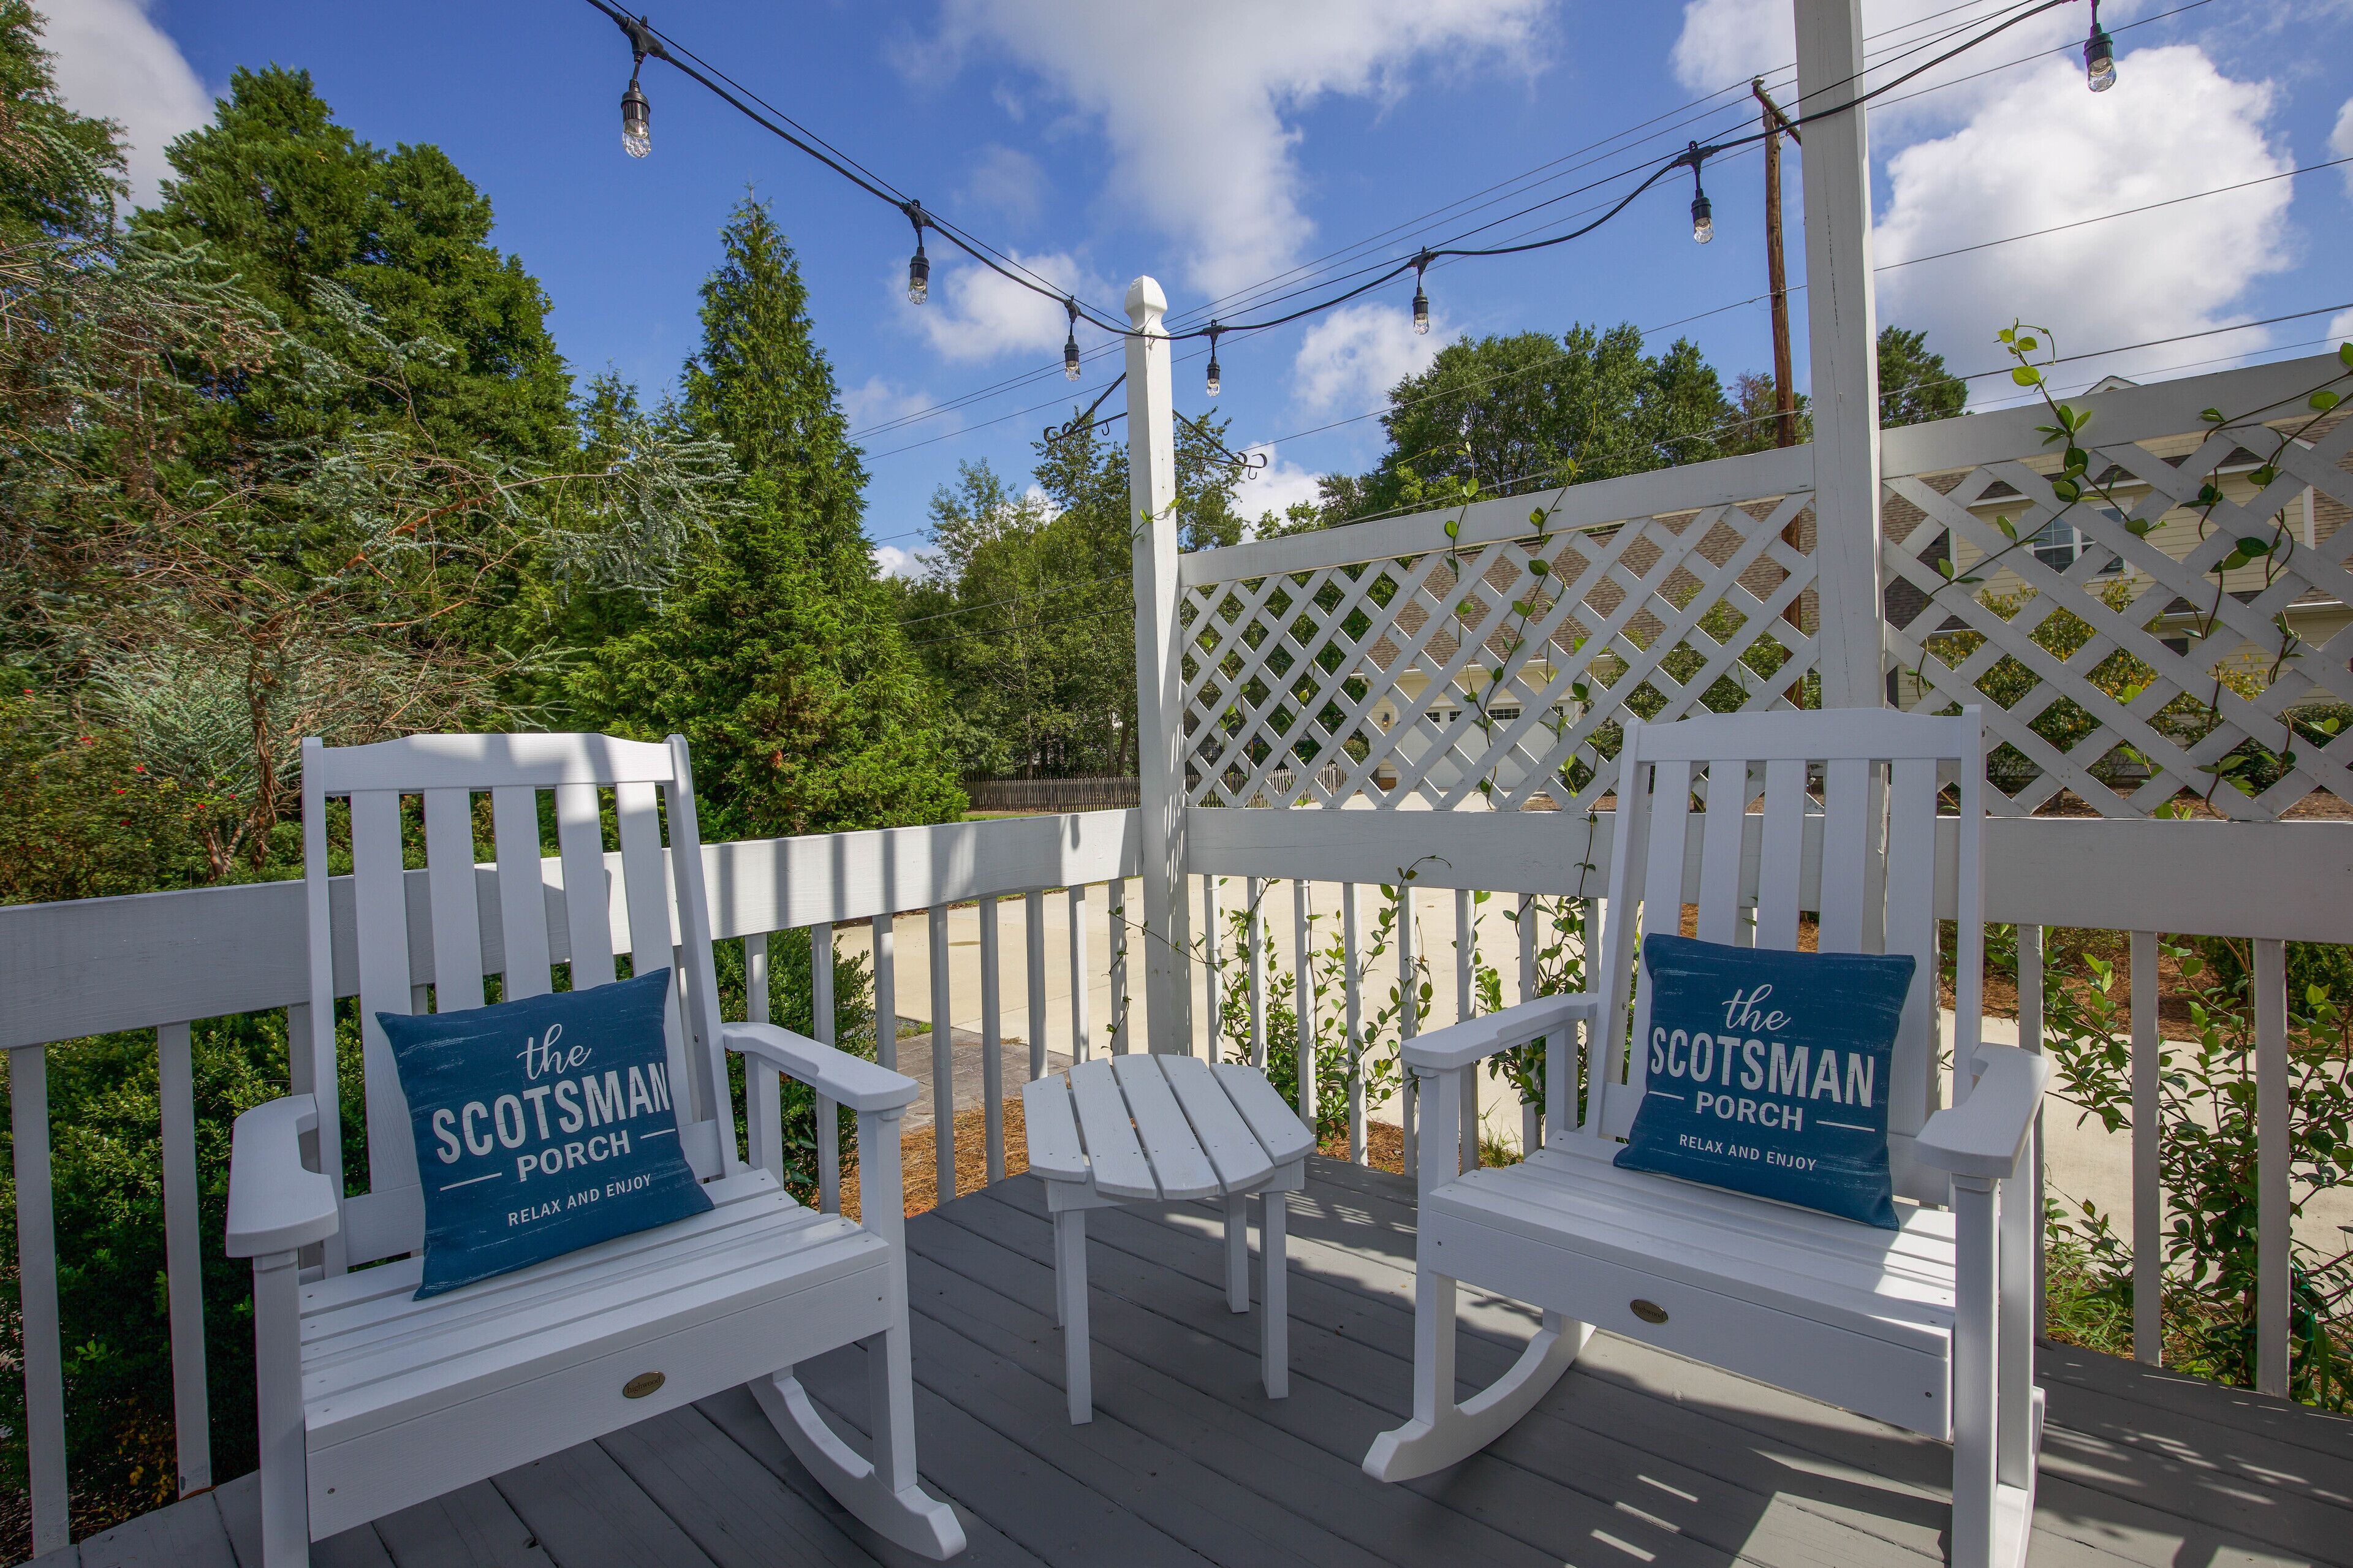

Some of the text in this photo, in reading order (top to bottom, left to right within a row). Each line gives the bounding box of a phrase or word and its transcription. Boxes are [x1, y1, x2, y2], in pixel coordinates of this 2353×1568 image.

[1722, 983, 1791, 1032] the
[517, 1023, 591, 1080] the
[1651, 1027, 1874, 1107] SCOTSMAN
[433, 1062, 671, 1164] SCOTSMAN
[1696, 1091, 1803, 1132] PORCH
[517, 1129, 631, 1182] PORCH
[1680, 1134, 1817, 1172] RELAX AND ENJOY
[507, 1173, 651, 1226] RELAX AND ENJOY
[627, 1376, 661, 1393] highwood
